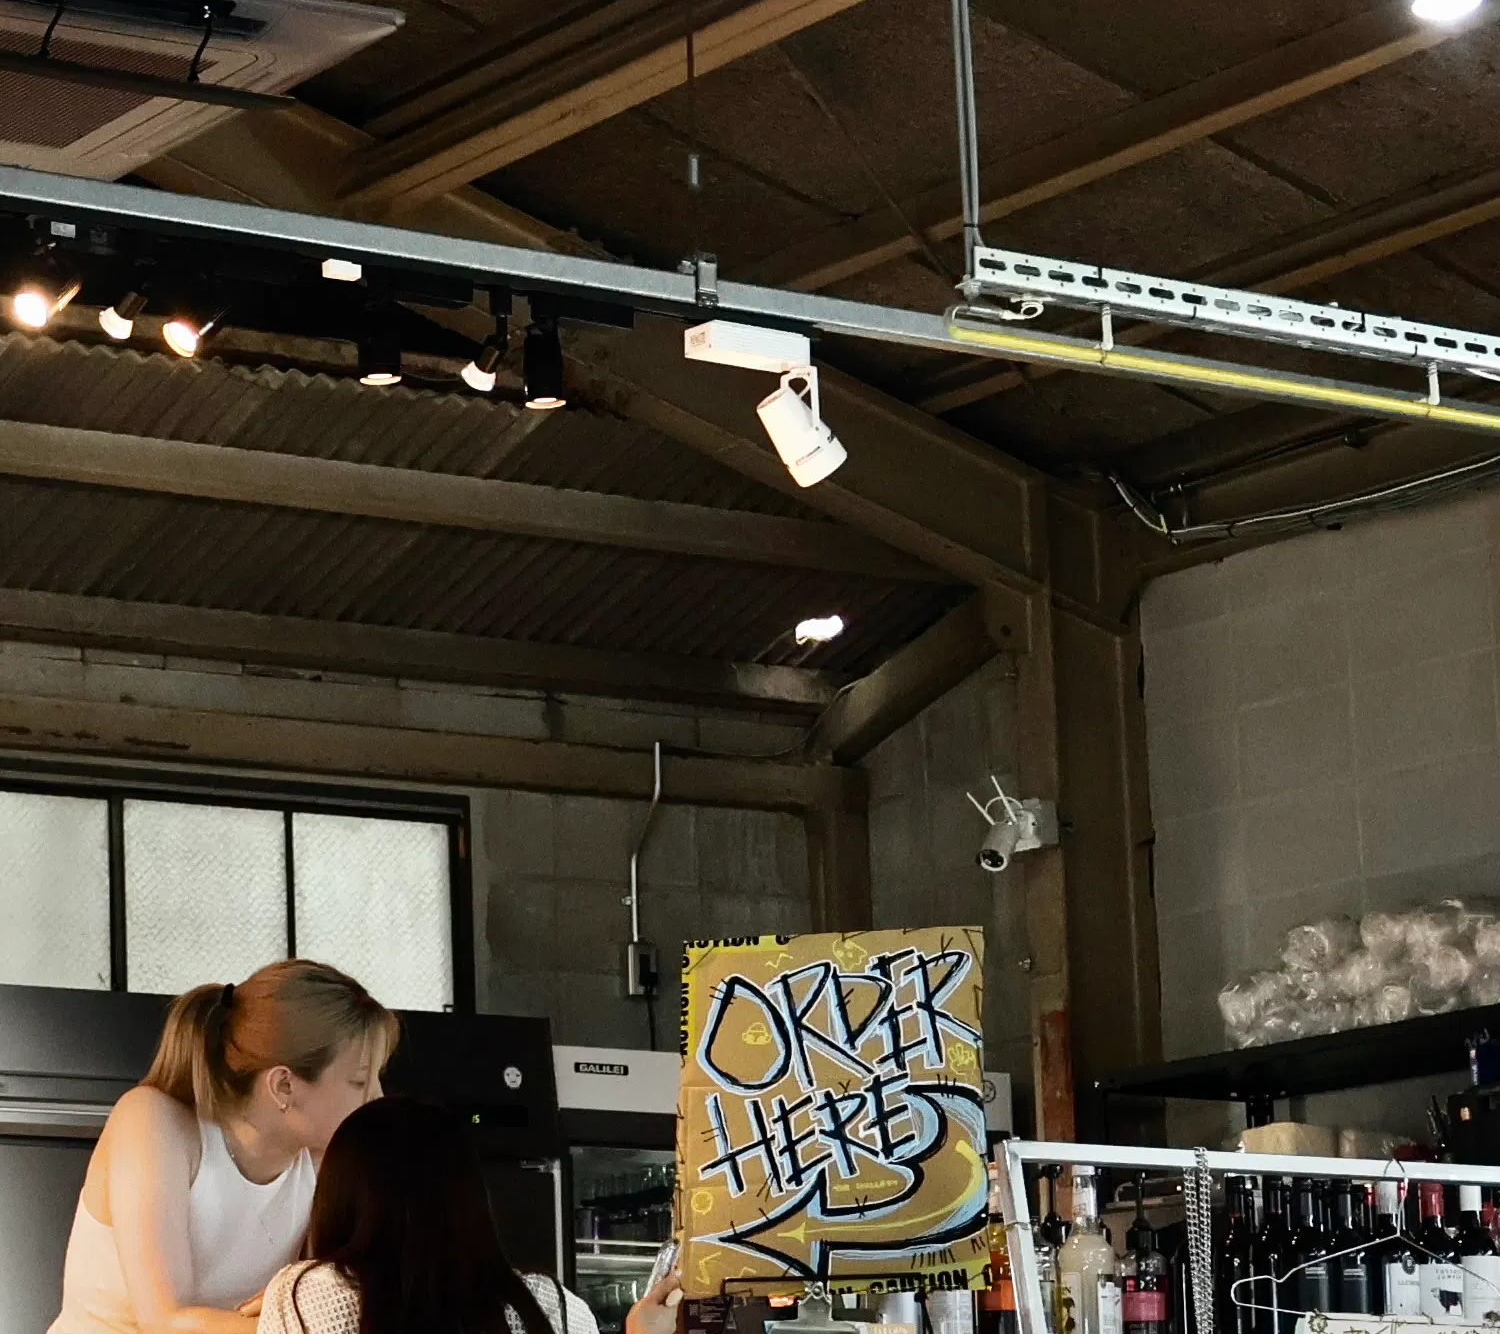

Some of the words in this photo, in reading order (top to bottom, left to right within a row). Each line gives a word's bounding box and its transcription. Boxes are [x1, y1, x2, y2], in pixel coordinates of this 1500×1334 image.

[579, 1064, 624, 1075] GALILEI
[696, 946, 983, 1096] ORDER
[698, 1073, 924, 1197] HERE
